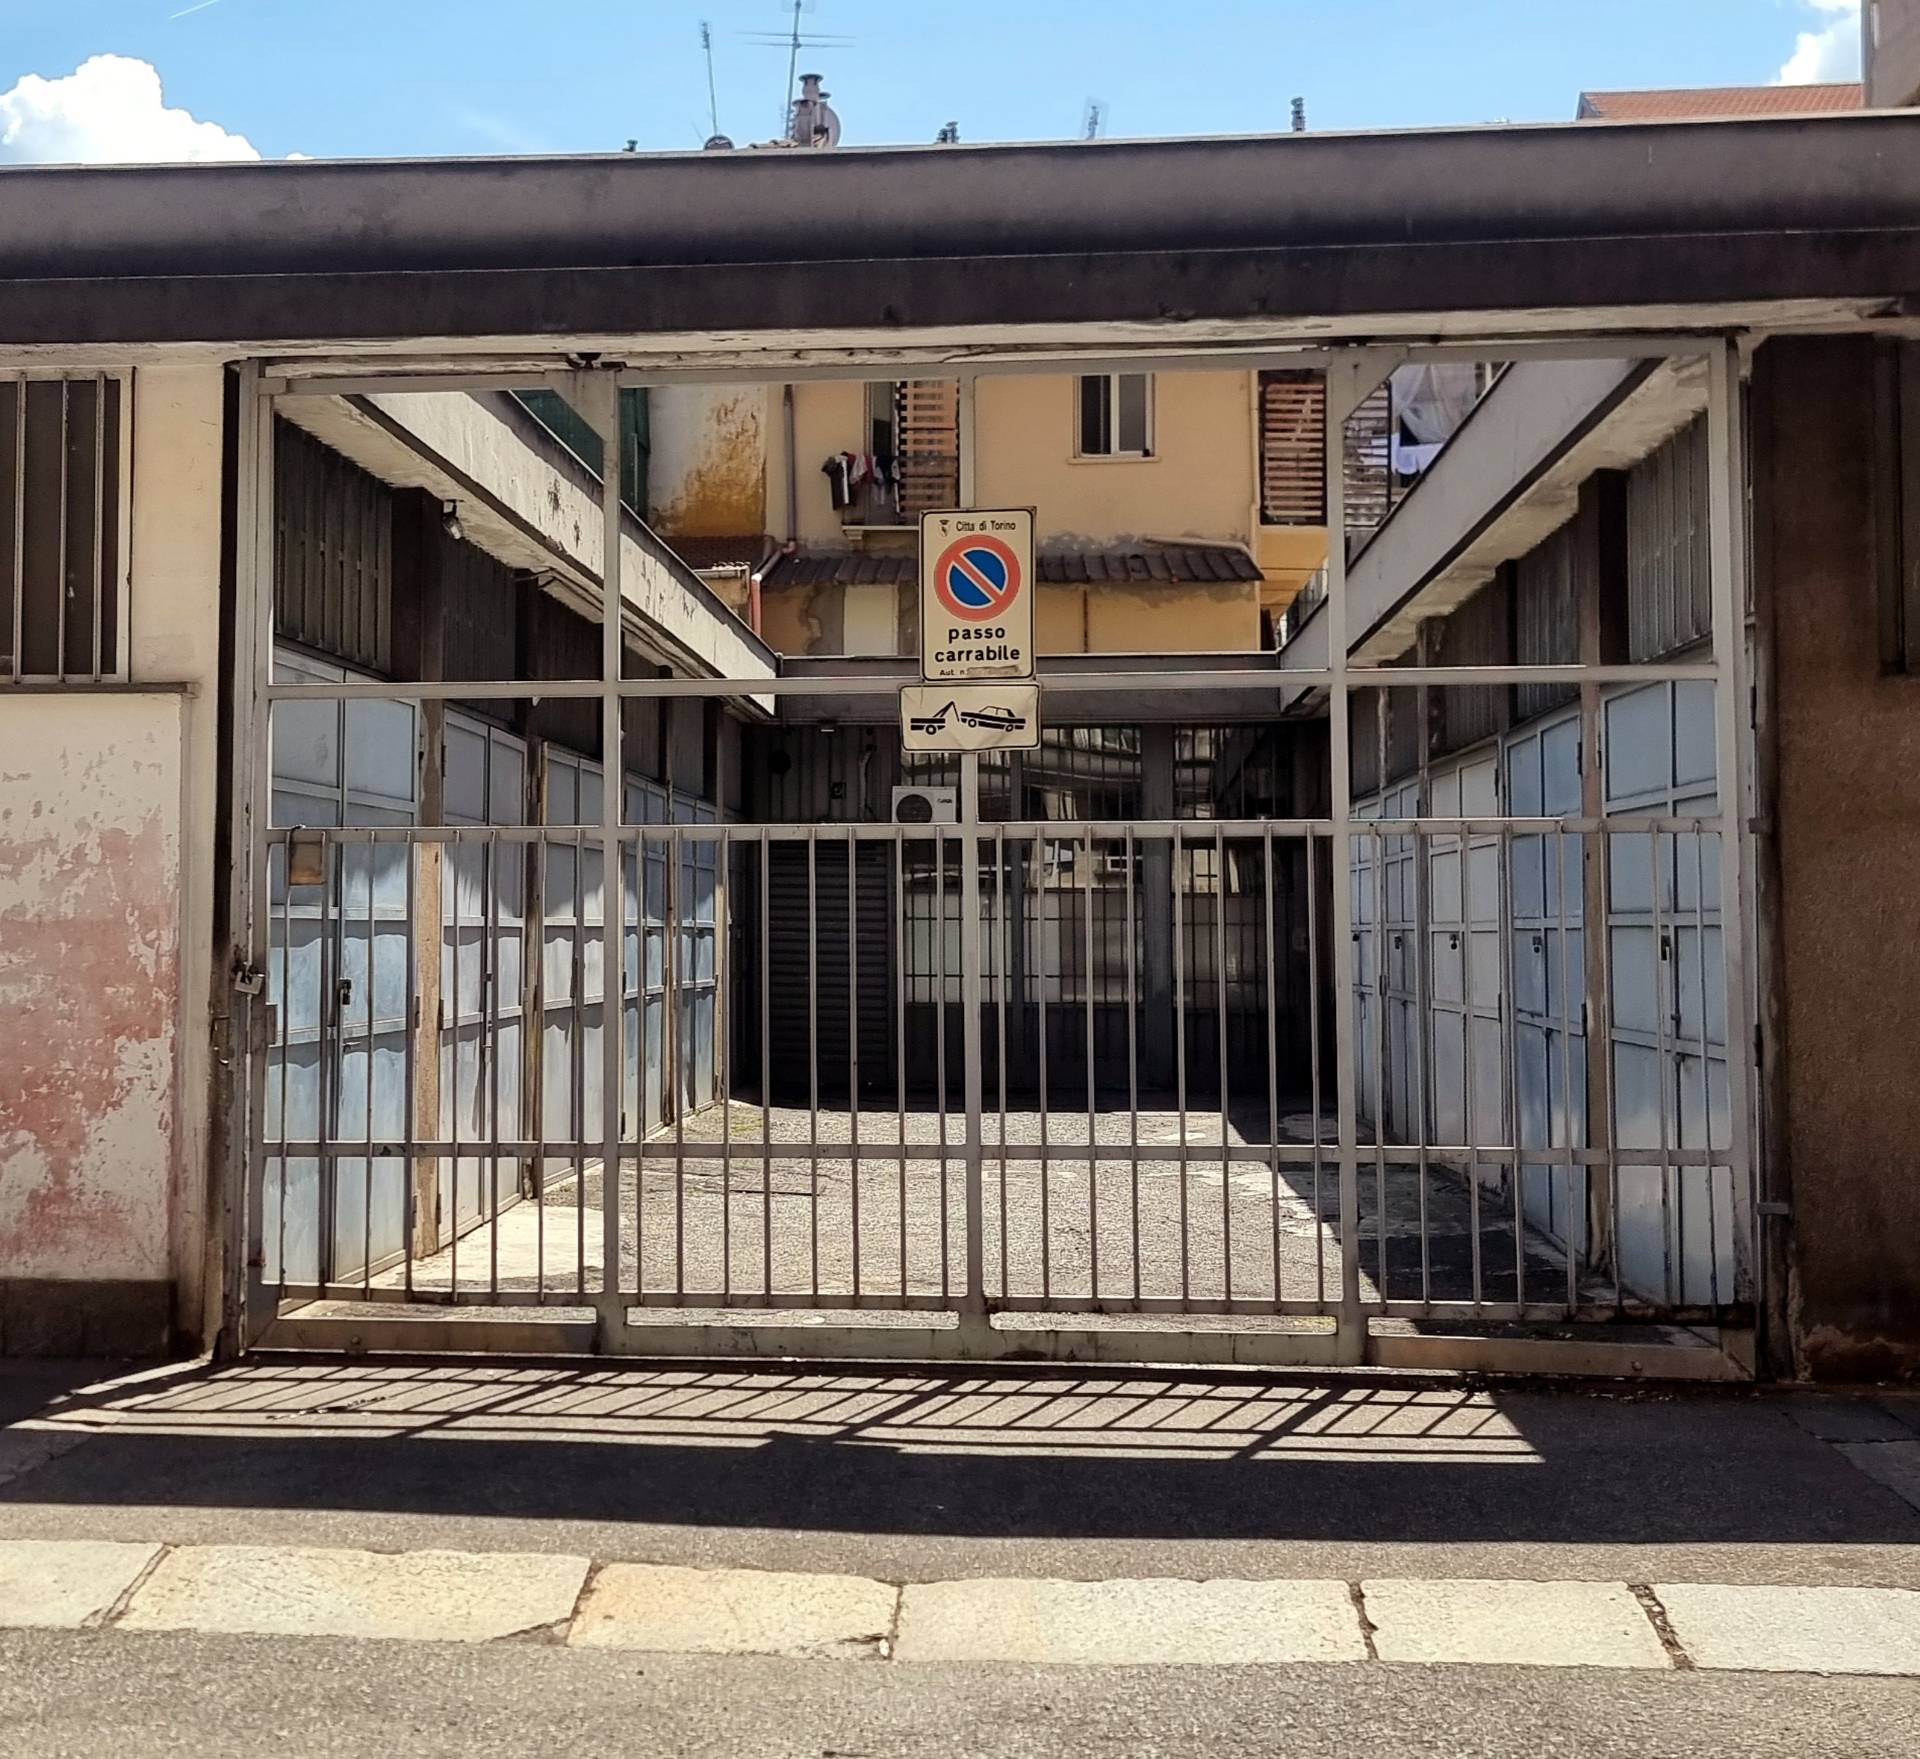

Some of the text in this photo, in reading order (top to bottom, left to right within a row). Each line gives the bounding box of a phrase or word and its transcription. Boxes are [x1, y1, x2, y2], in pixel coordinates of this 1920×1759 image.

[979, 521, 987, 531] di
[991, 520, 1016, 531] Torino
[948, 627, 1005, 644] passo
[934, 645, 1020, 663] carrabile
